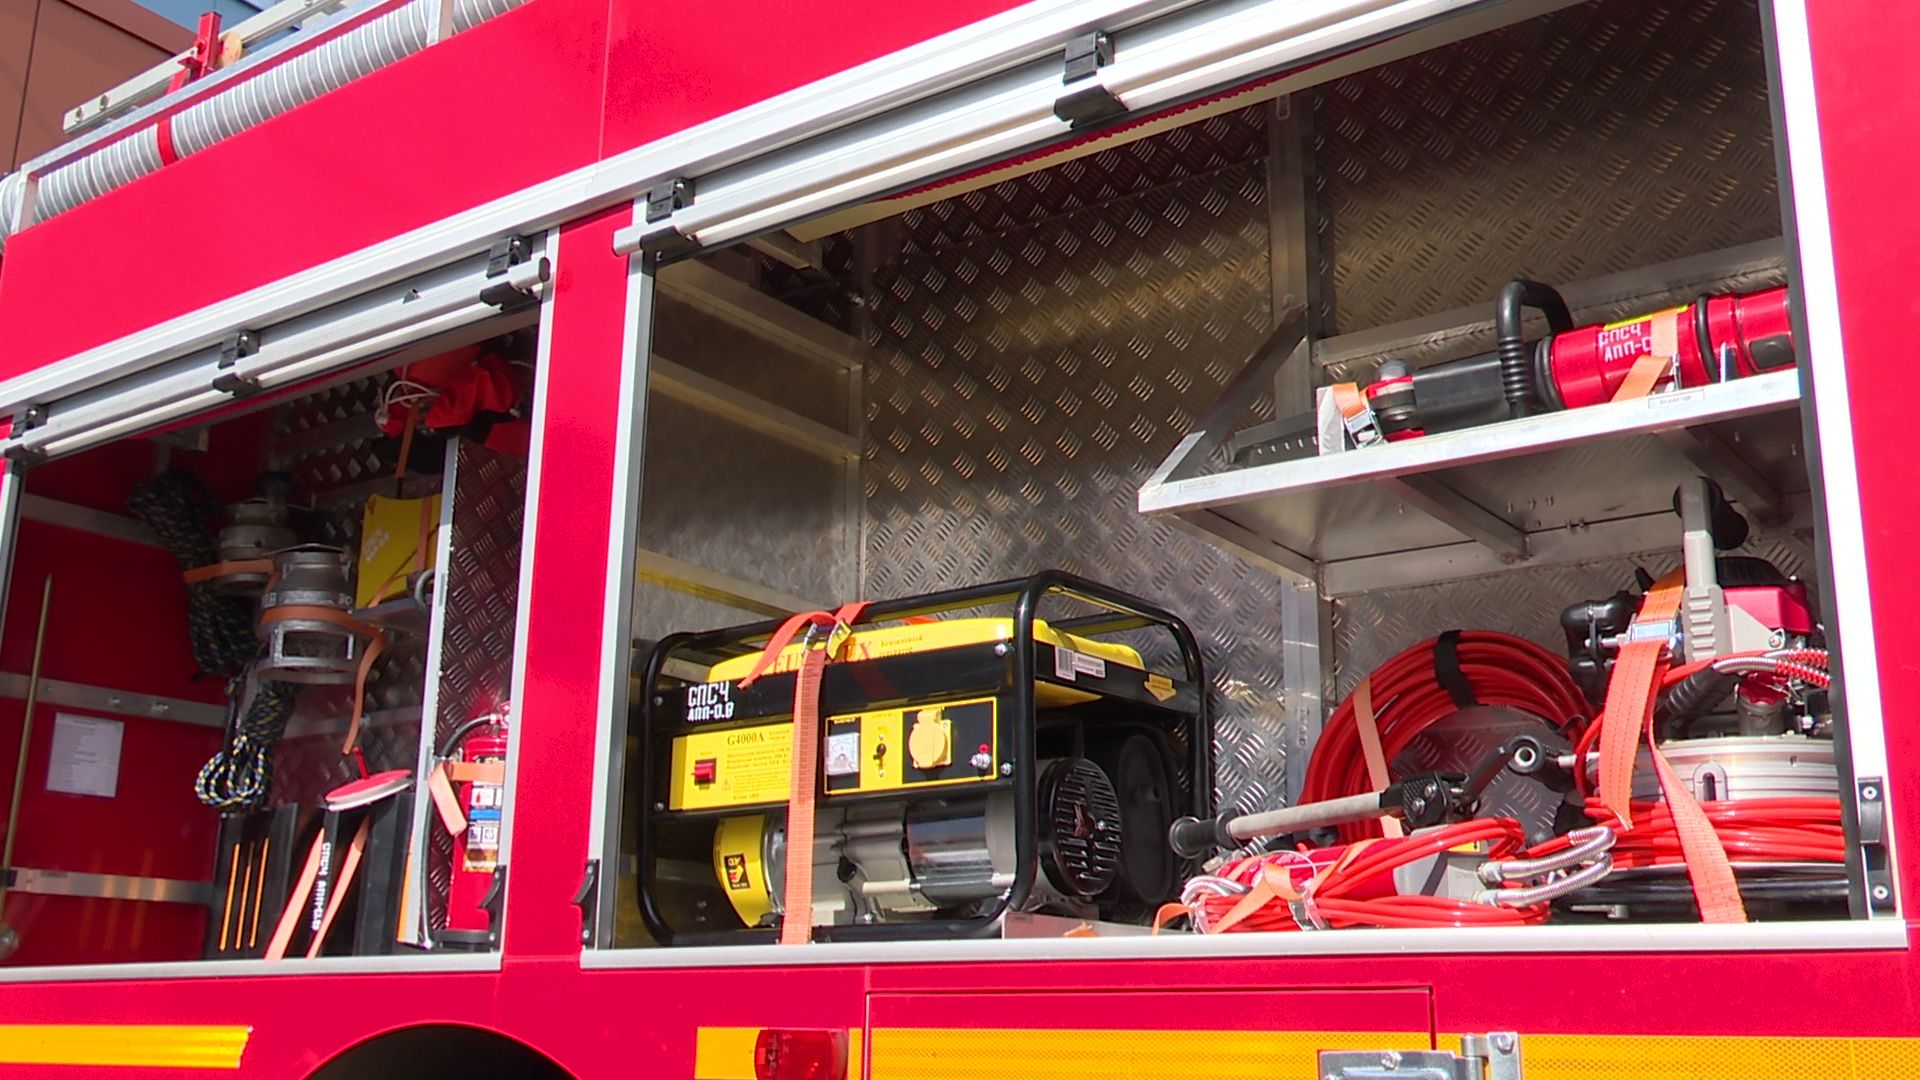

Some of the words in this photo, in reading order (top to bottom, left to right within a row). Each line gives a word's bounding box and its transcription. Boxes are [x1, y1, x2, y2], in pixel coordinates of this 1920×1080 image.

[1598, 323, 1641, 349] СПСЧ
[1604, 335, 1652, 363] АПП-0
[688, 680, 730, 707] СПСЧ
[727, 732, 765, 746] G4000A
[318, 841, 331, 876] СПСЧ
